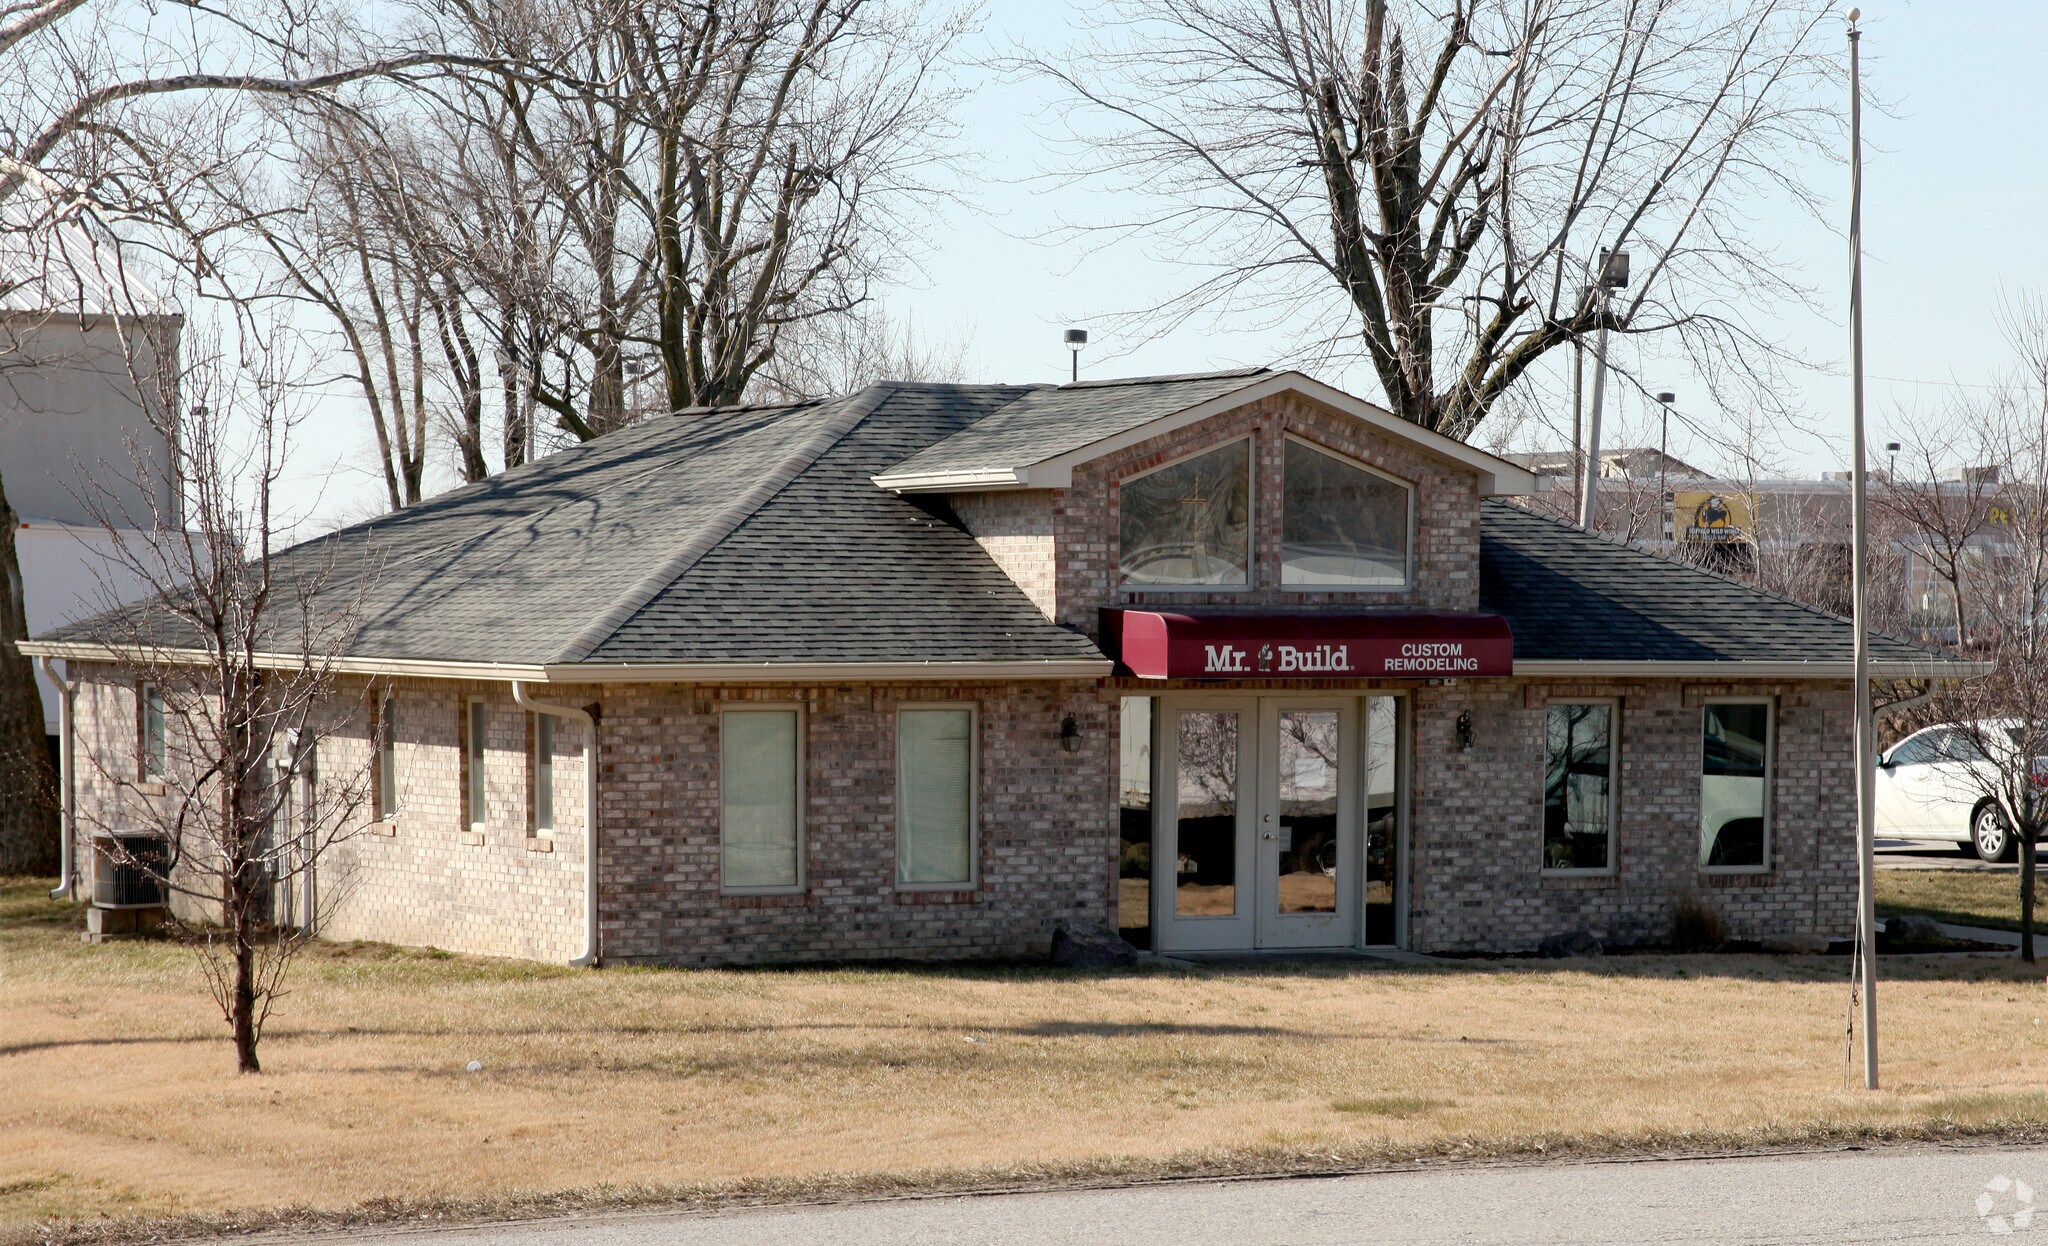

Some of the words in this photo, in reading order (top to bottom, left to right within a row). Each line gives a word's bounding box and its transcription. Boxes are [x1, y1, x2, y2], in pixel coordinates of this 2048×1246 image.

[1401, 643, 1462, 657] CUSTOM
[1204, 645, 1251, 672] Mr.
[1384, 658, 1478, 671] REMODELING
